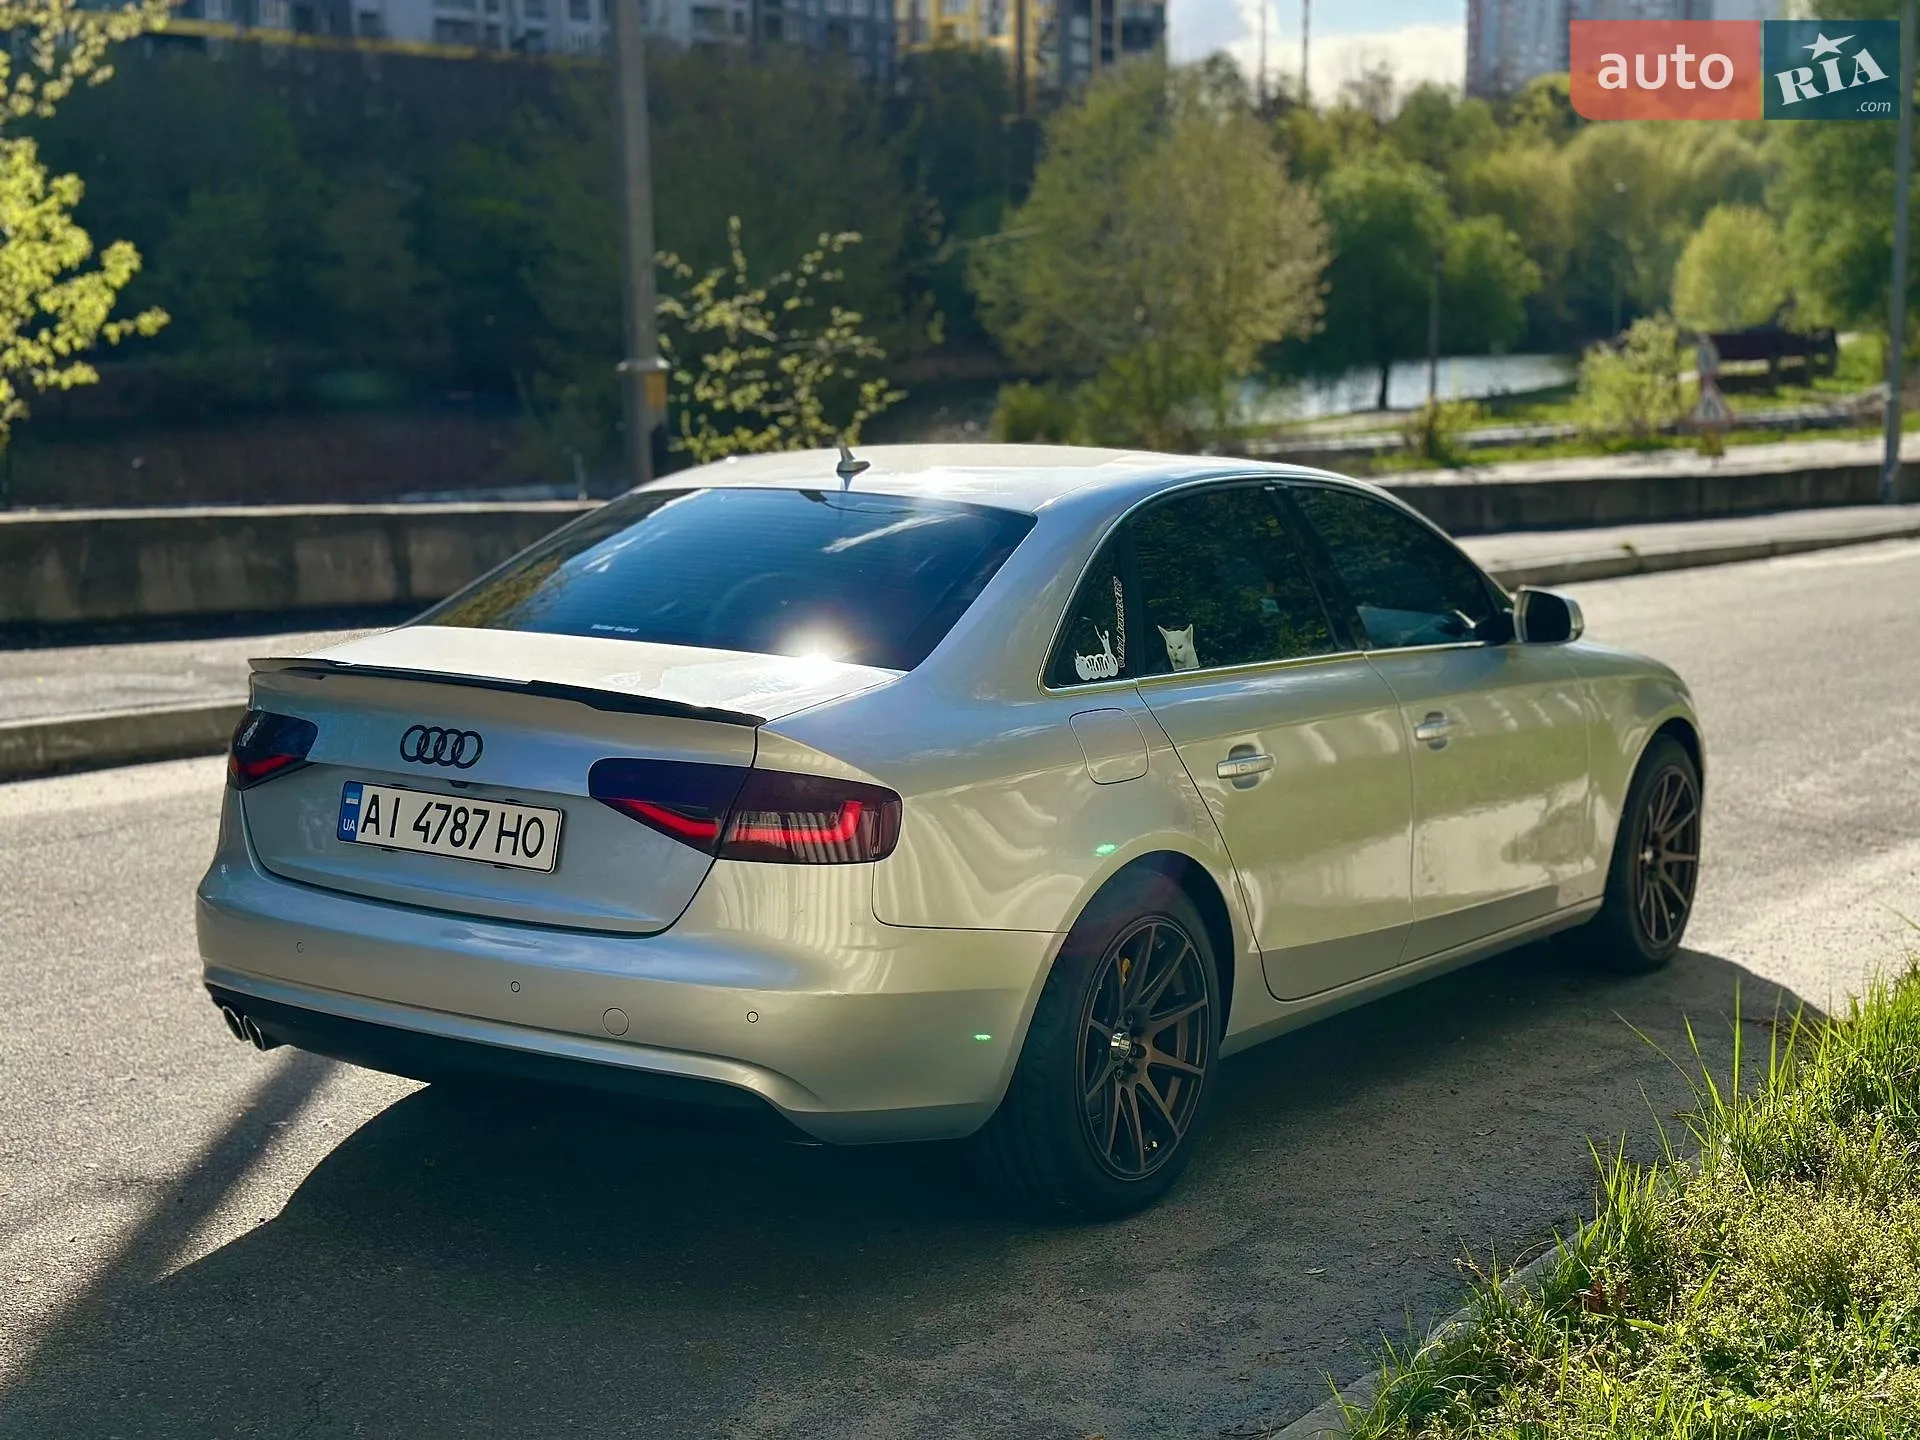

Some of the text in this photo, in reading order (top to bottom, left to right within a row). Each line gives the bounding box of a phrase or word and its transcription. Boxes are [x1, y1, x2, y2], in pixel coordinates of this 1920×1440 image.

[342, 818, 356, 832] UA
[360, 794, 545, 858] AI 4787 HO
